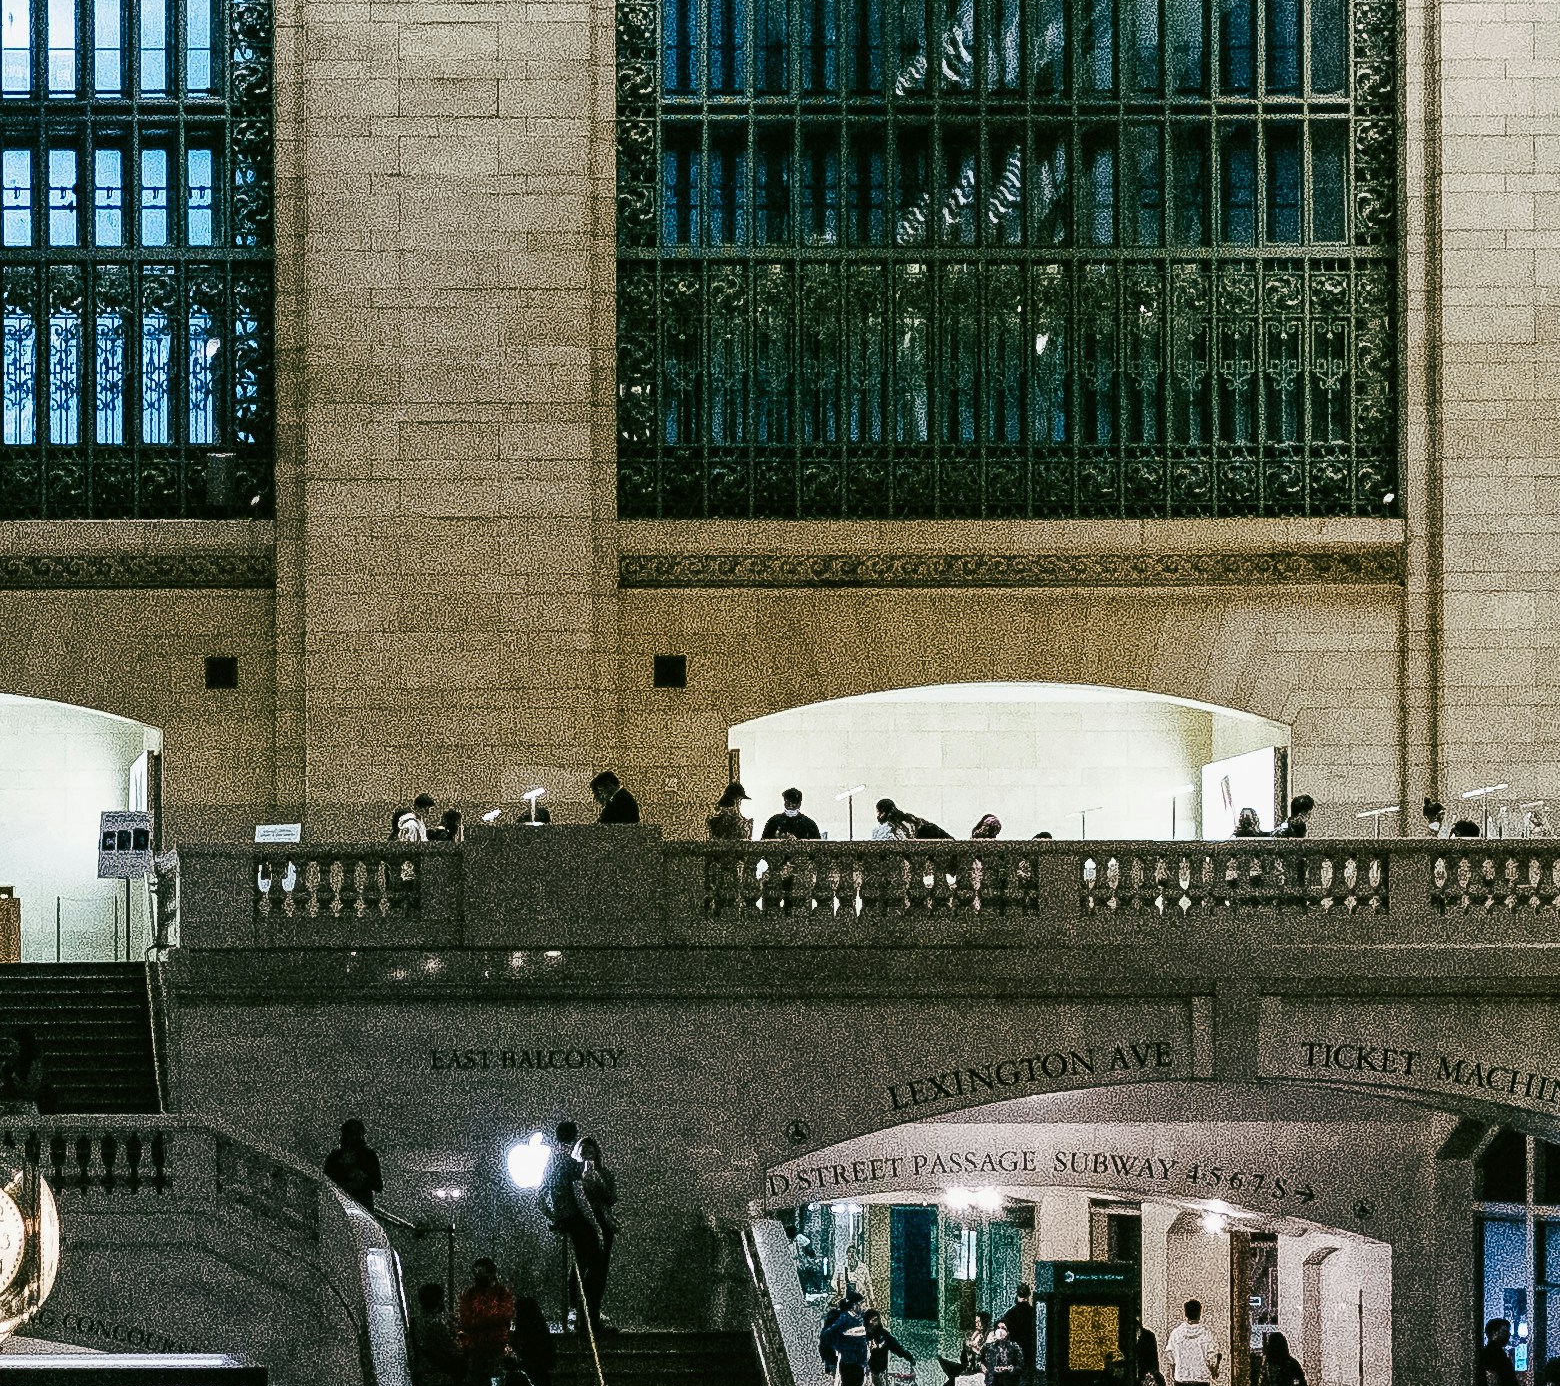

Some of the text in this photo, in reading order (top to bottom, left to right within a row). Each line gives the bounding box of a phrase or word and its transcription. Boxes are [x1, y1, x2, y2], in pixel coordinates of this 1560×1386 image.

[432, 1049, 624, 1069] EAST BALCONY
[888, 1042, 1171, 1111] LEXINGTON AVE
[1301, 1042, 1421, 1075] TICKET
[797, 1157, 904, 1189] STREET
[914, 1150, 1036, 1175] PASSAGE
[1054, 1151, 1176, 1181] SUBWAY
[1, 1233, 10, 1250] 3
[63, 1313, 196, 1353] CONCOUR
